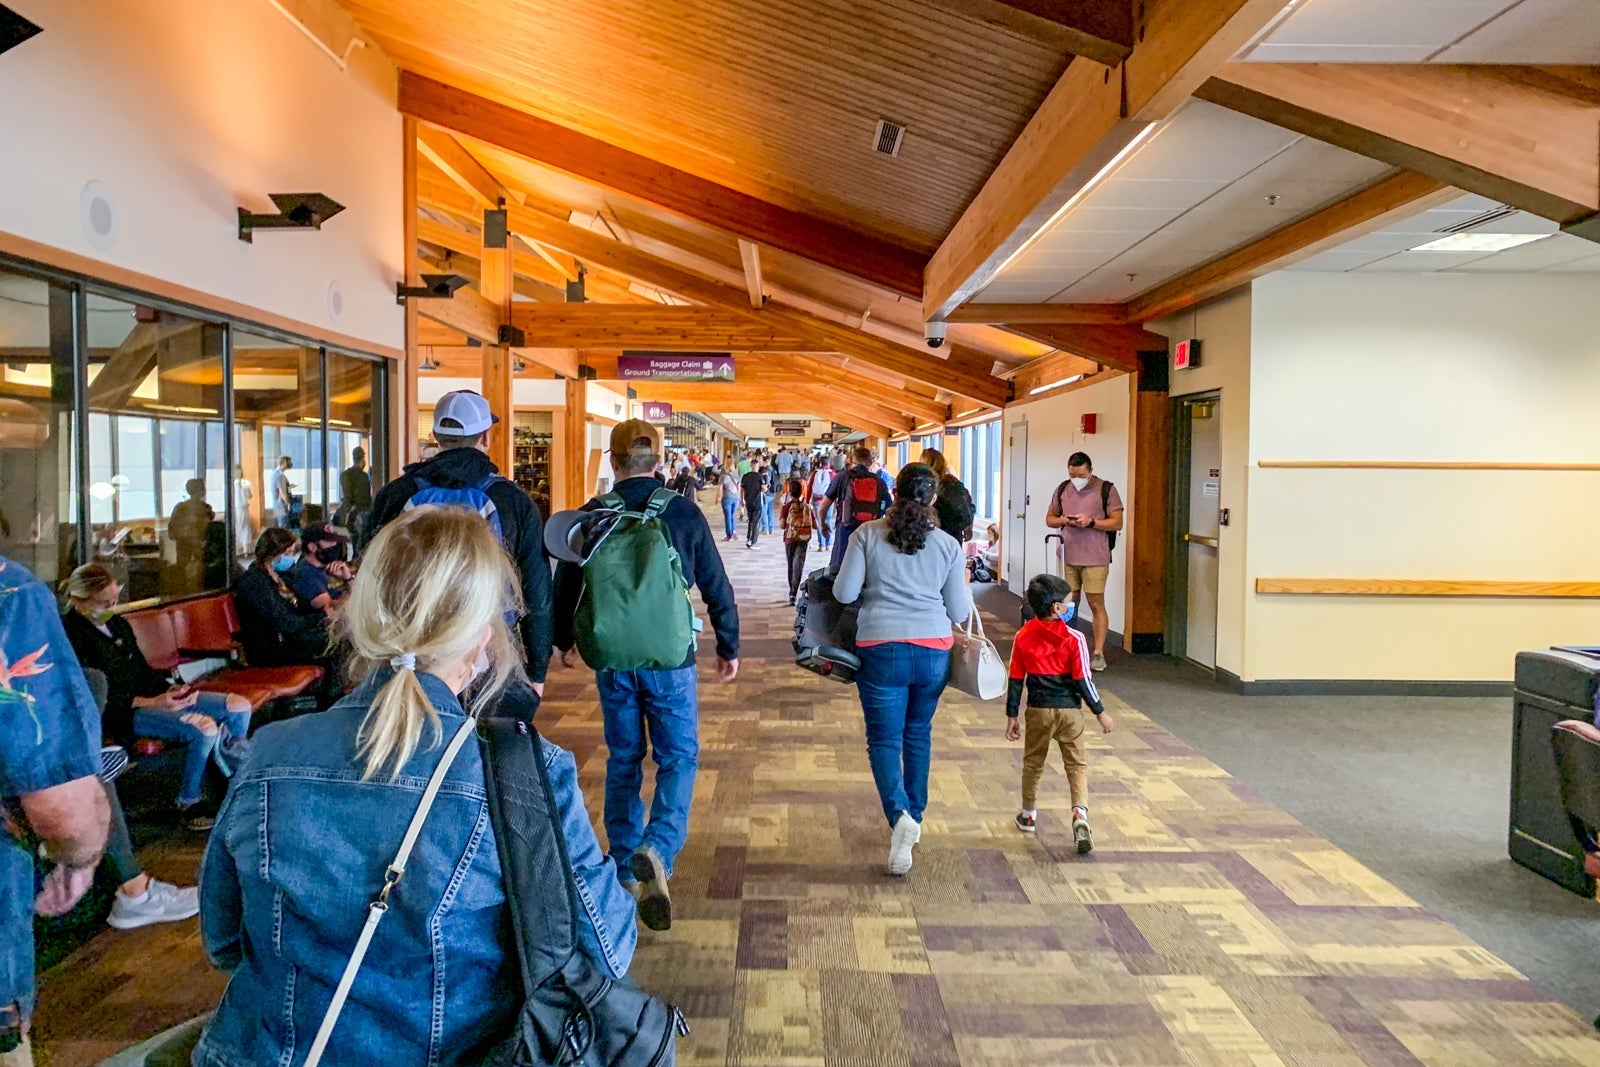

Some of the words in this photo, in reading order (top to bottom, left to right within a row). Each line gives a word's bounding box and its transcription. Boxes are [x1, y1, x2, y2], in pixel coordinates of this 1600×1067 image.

[650, 360, 680, 369] Baggage
[681, 360, 701, 368] Claim
[624, 368, 650, 376] Ground
[651, 369, 701, 377] Transportation
